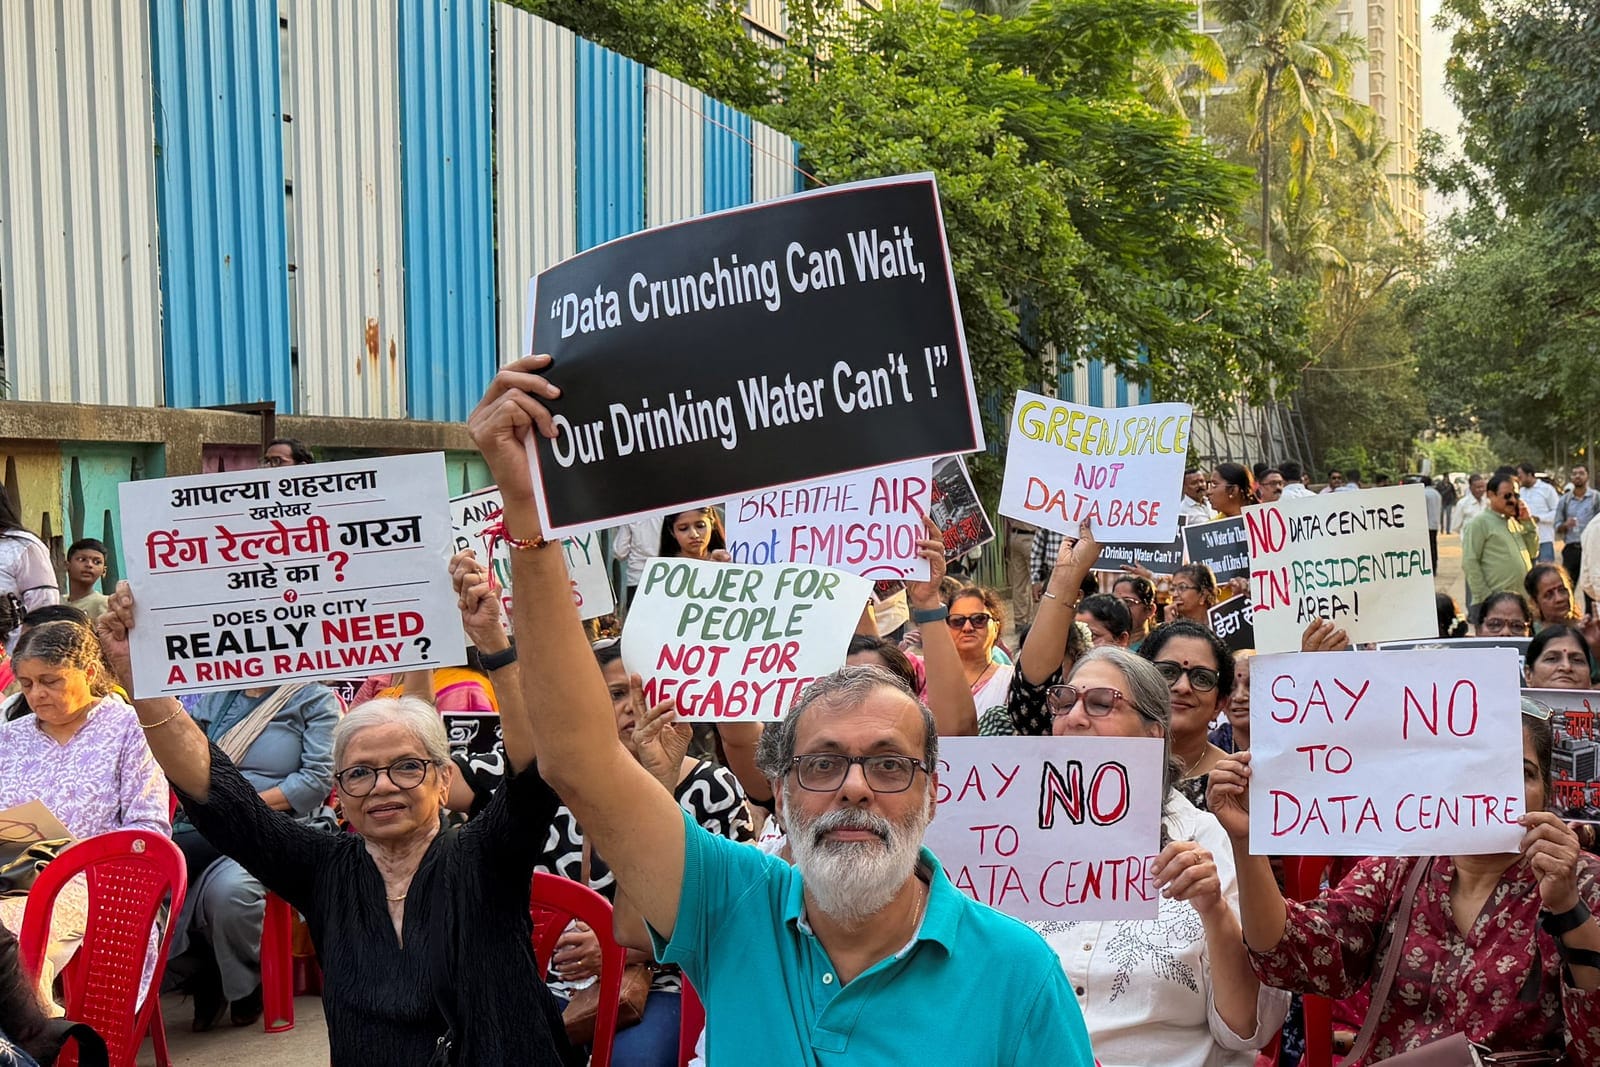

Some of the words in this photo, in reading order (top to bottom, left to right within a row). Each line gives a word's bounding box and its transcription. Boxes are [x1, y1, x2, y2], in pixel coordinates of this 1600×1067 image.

[551, 285, 621, 338] “Data
[629, 253, 781, 322] Crunching
[786, 242, 845, 293] Can
[848, 225, 926, 285] Wait,
[551, 414, 604, 468] Our
[610, 389, 738, 457] Drinking
[738, 374, 825, 431] Water
[171, 481, 271, 509] आपल्या
[278, 469, 378, 498] शहराला
[1074, 463, 1125, 490] NOT
[249, 502, 312, 521] खरोखर
[738, 484, 859, 523] BREATHE
[869, 476, 928, 517] AIR
[146, 528, 209, 569] रिंग
[215, 515, 331, 562] रेल्वेची
[338, 515, 423, 547] गरज
[730, 528, 783, 566] not
[1245, 506, 1286, 559] NO
[1288, 513, 1325, 544] DATA
[1325, 504, 1405, 534] CENTRE
[227, 563, 278, 590] आहे
[286, 563, 320, 584] का
[327, 551, 350, 582] ?
[1134, 548, 1153, 562] Water
[645, 562, 764, 604] POWER
[774, 567, 841, 601] FOR
[1252, 566, 1291, 612] IN
[1291, 550, 1432, 593] RESIDENTIAL
[213, 610, 267, 628] DOES
[273, 603, 317, 623] OUR
[322, 599, 367, 616] CITY
[676, 603, 813, 642] PEOPLE
[165, 622, 309, 661] REALLY
[322, 611, 425, 645] NEED
[167, 664, 188, 685] A
[196, 656, 264, 682] RING
[274, 642, 404, 674] RAILWAY
[413, 636, 432, 660] ?
[656, 643, 731, 677] NOT
[741, 642, 800, 675] FOR
[1270, 675, 1370, 724] SAY
[1402, 680, 1479, 740] NO
[1296, 744, 1352, 774] TO
[1038, 760, 1130, 830] NO
[1270, 790, 1381, 837] DATA
[1395, 793, 1518, 833] CENTRE
[969, 824, 1019, 857] TO
[943, 864, 1030, 906] ATA
[1039, 856, 1156, 907] CENTRE
